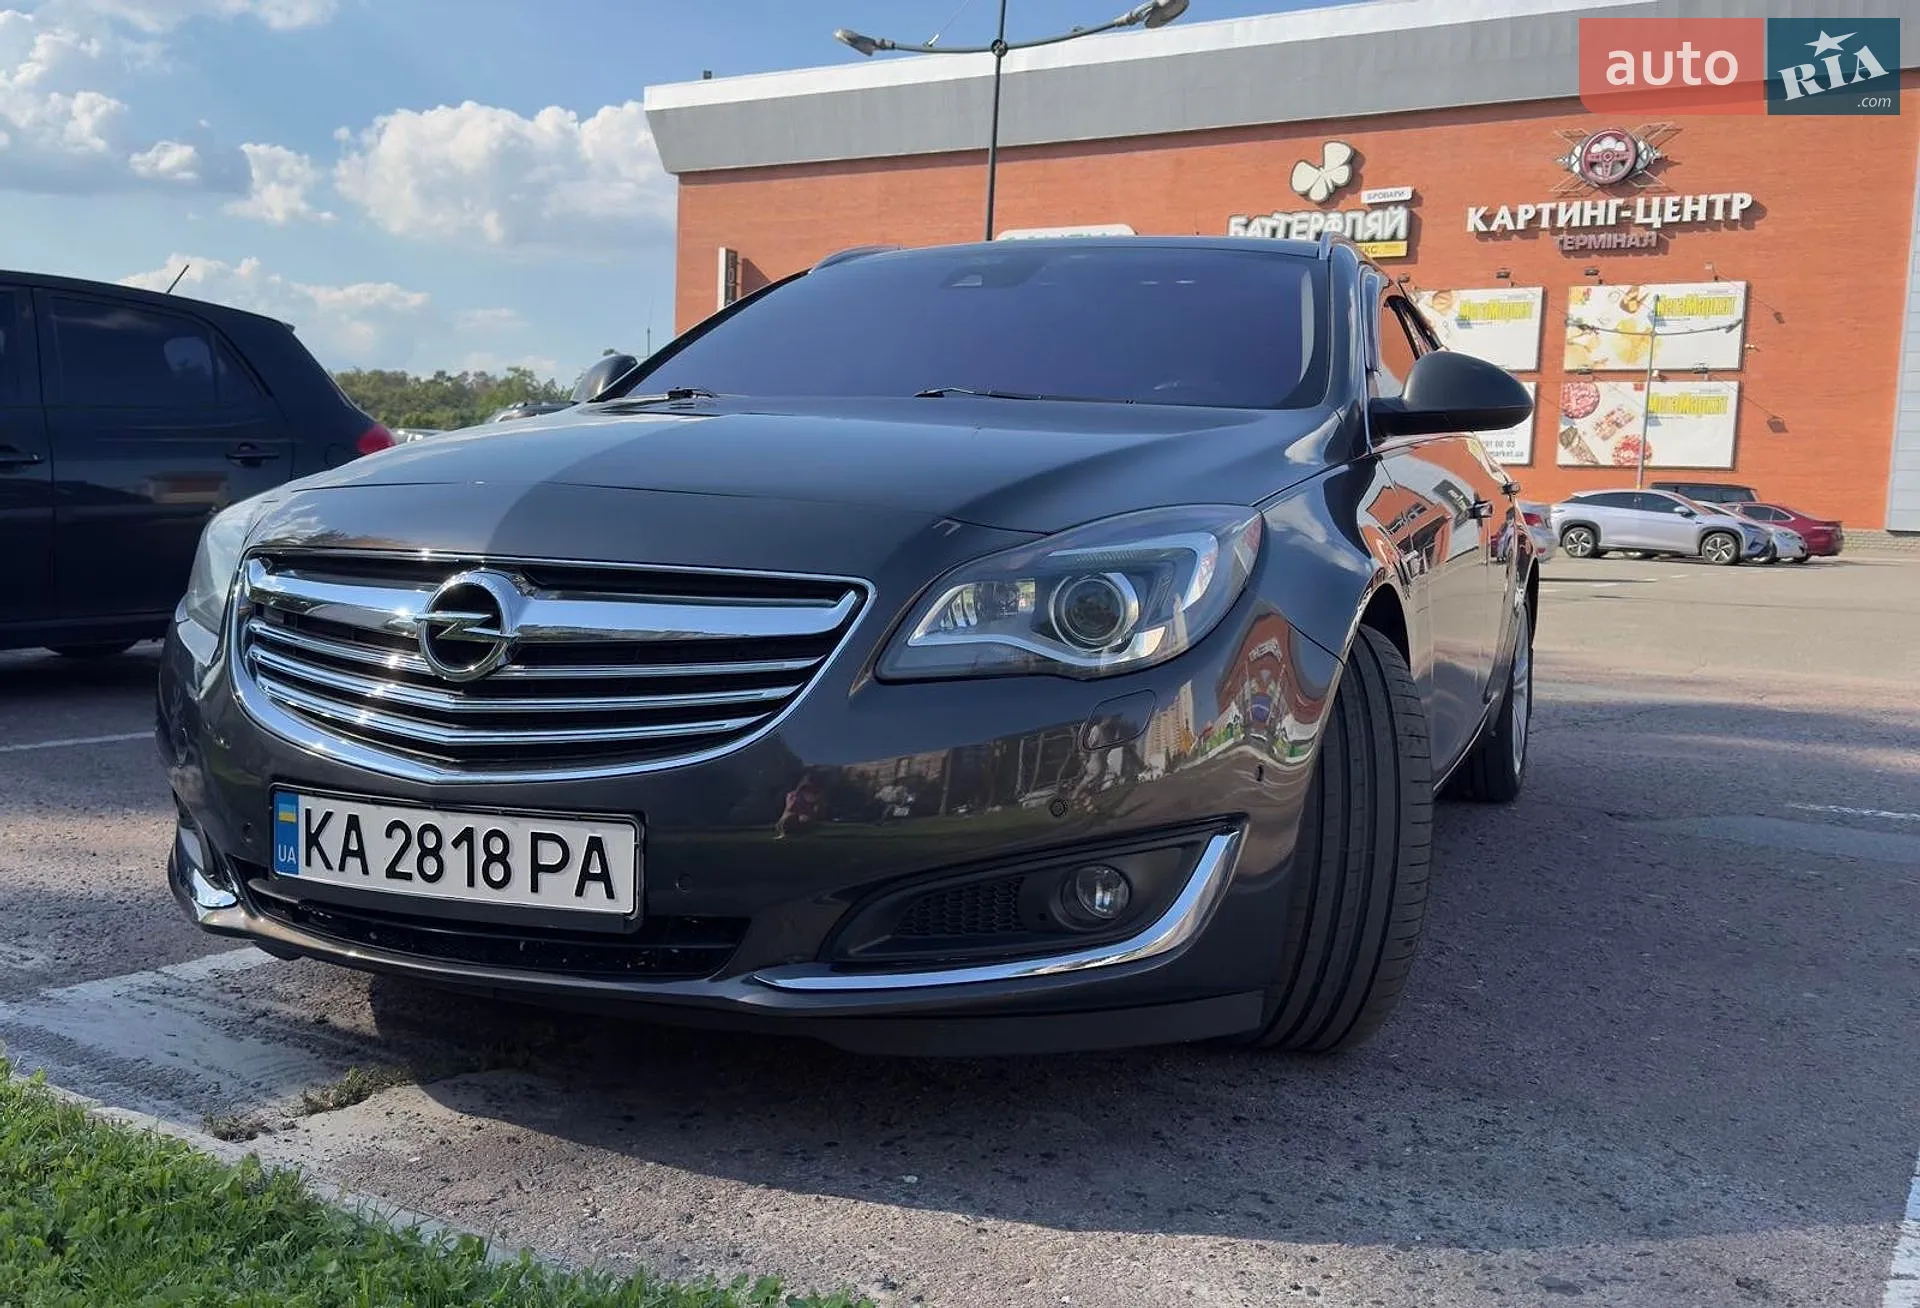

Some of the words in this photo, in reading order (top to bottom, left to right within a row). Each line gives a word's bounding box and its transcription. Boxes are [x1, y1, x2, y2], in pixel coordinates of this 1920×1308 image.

[1466, 192, 1754, 233] КАРТИНГ-ЦЕНТР
[278, 844, 298, 864] UA
[304, 806, 370, 876] KA
[383, 818, 513, 890] 2818
